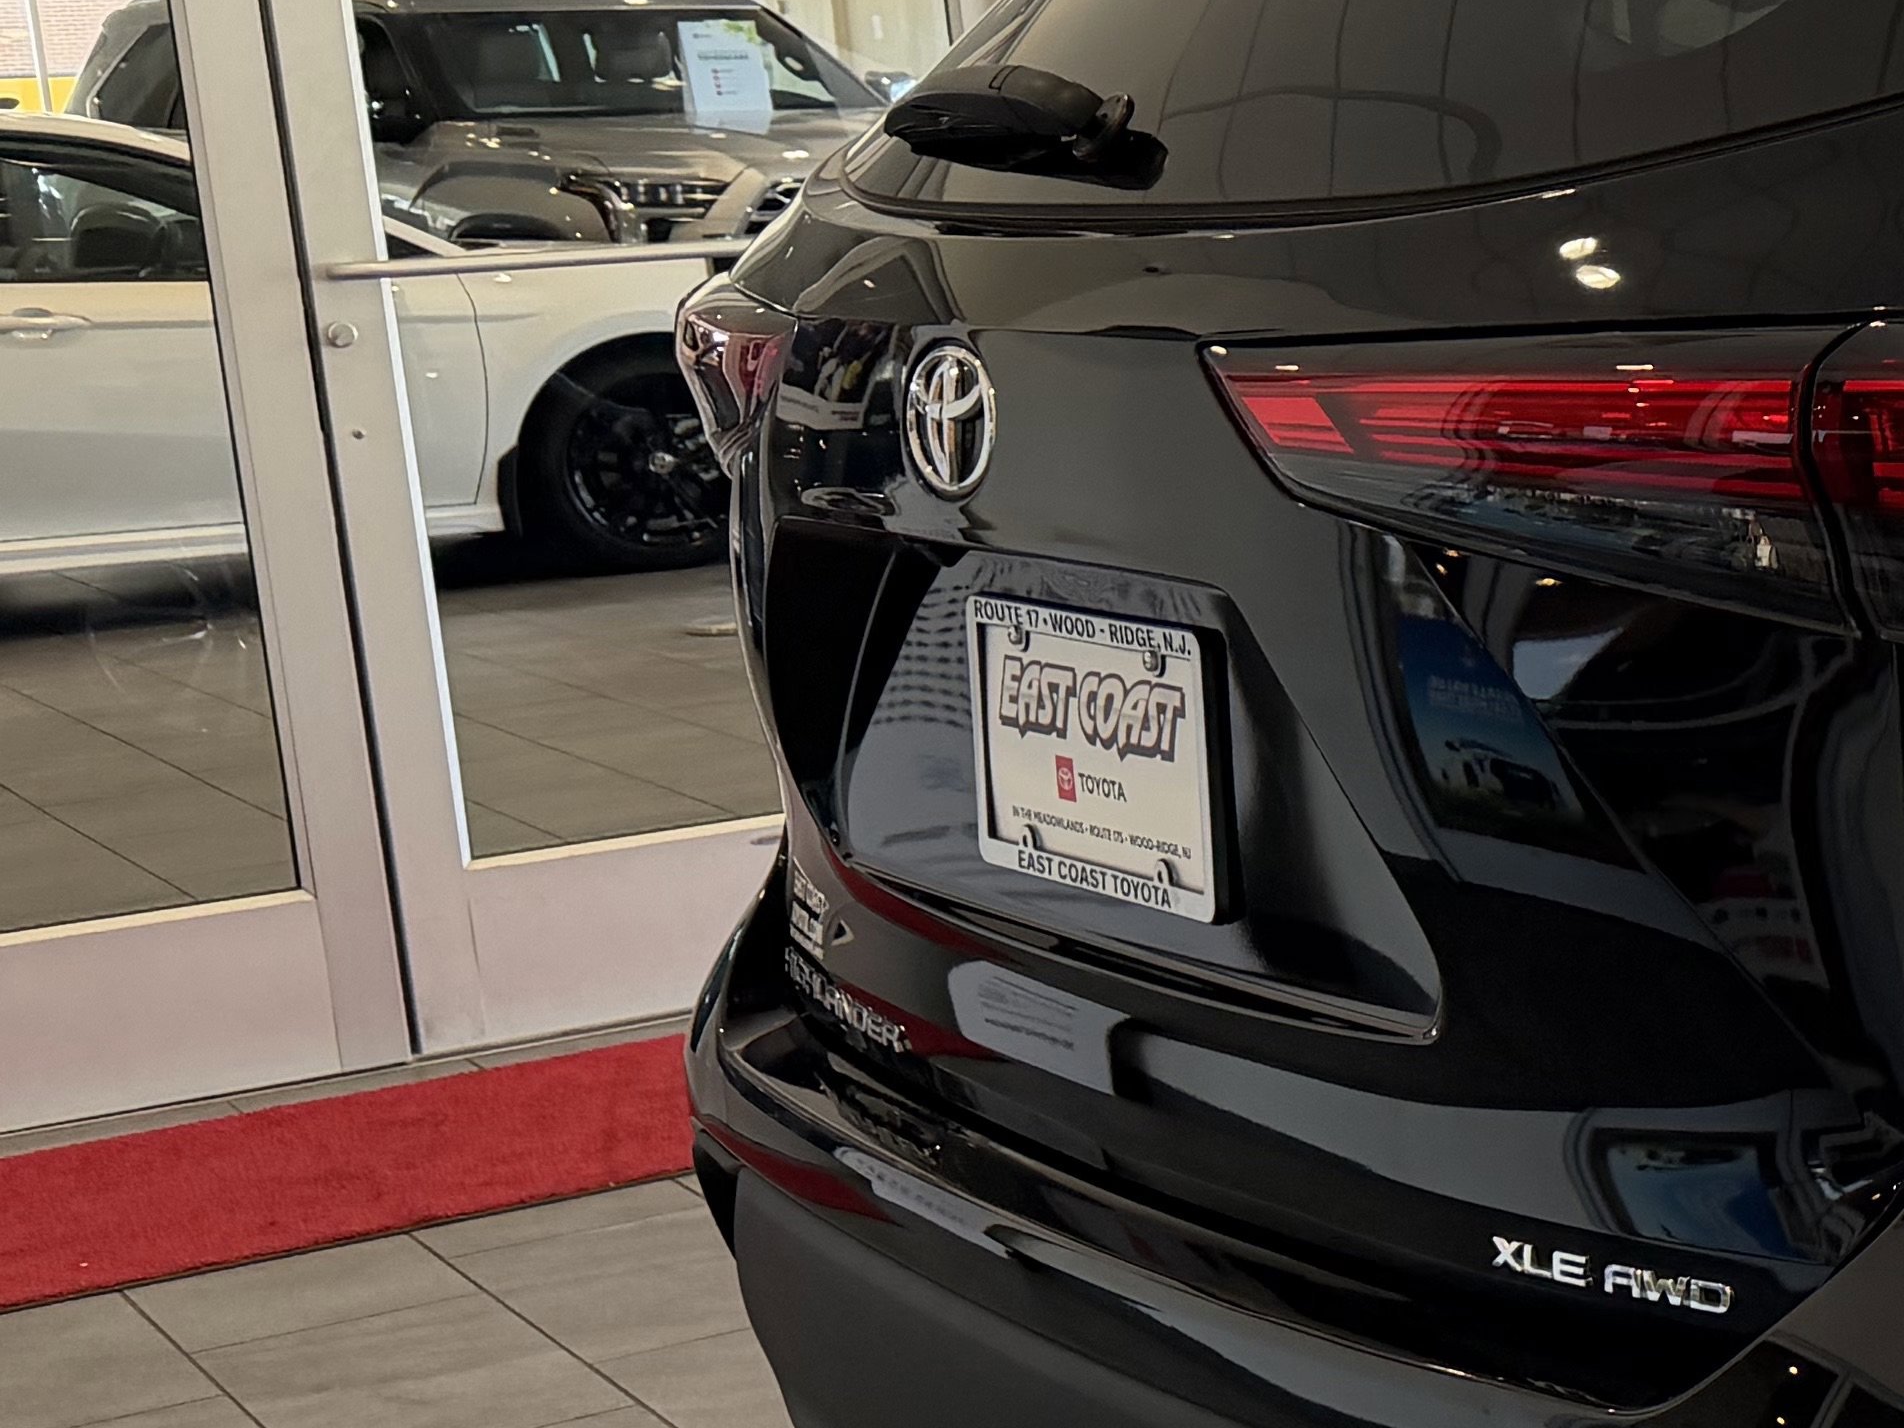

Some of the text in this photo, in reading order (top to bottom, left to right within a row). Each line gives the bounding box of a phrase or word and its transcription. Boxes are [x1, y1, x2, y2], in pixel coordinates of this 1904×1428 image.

[974, 600, 1023, 625] ROUTE
[1026, 609, 1039, 628] 17
[1050, 613, 1096, 639] WOOD
[1108, 623, 1161, 652] RIDGE,
[1163, 633, 1192, 656] N.J.
[999, 654, 1186, 762] EAST COAST
[1078, 772, 1128, 803] TOYOTA
[1018, 849, 1171, 908] EAST COAST TOYOTA
[1492, 1236, 1735, 1314] XLE AWD
